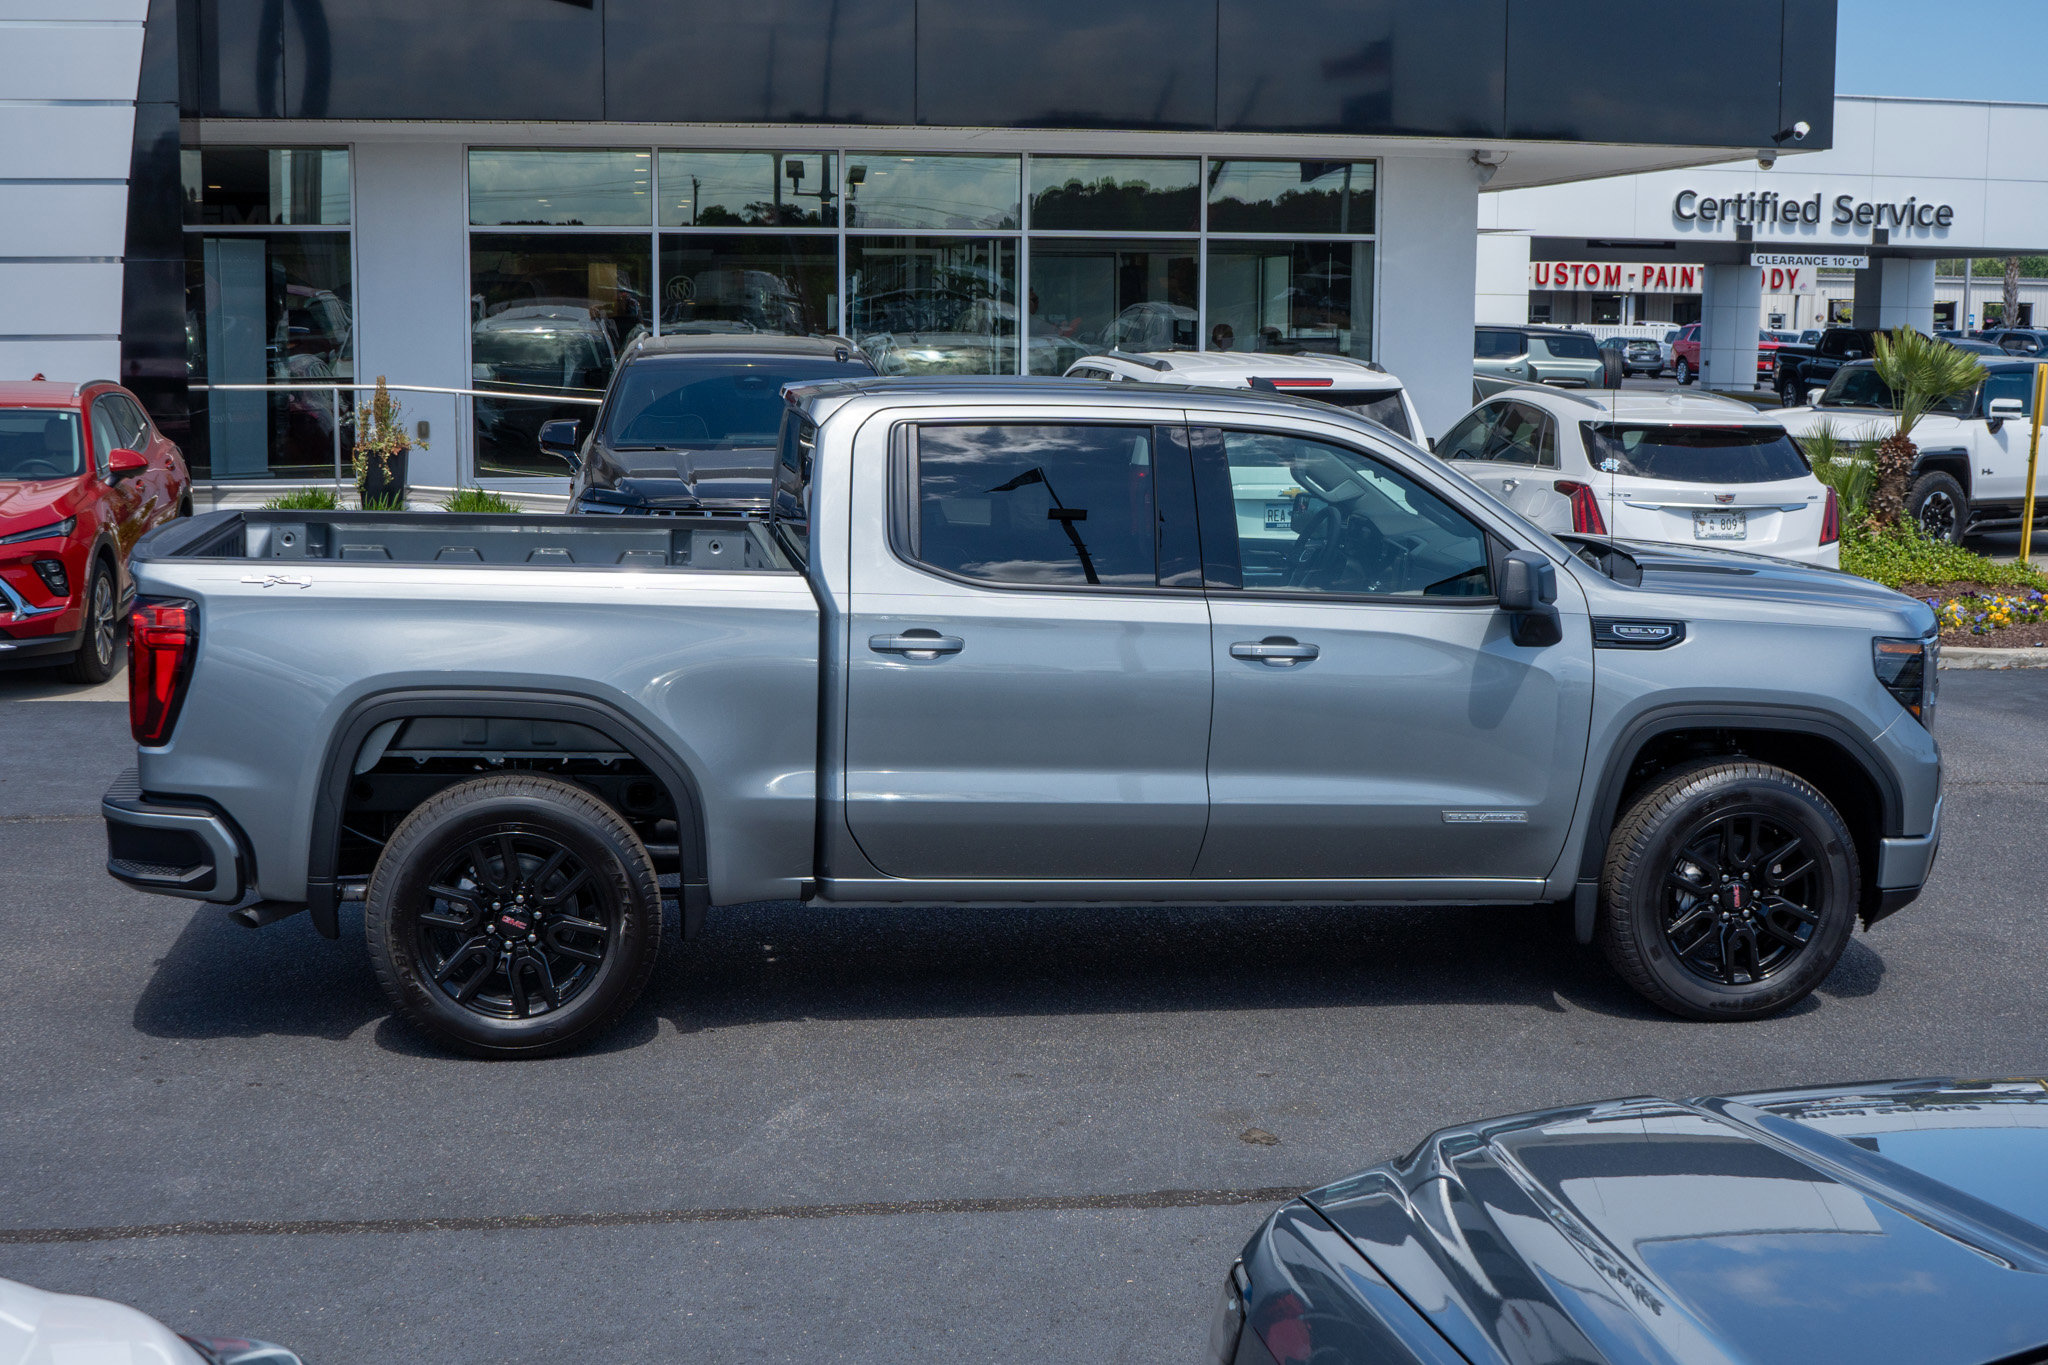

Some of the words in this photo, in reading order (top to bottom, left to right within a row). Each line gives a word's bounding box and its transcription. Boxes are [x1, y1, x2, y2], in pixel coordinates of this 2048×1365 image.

[1673, 189, 1823, 225] Certified
[1832, 194, 1954, 228] Service
[1757, 255, 1828, 266] CLEARANCE
[1529, 262, 1621, 287] USTOM
[1761, 268, 1799, 290] DY
[1720, 518, 1738, 531] 809
